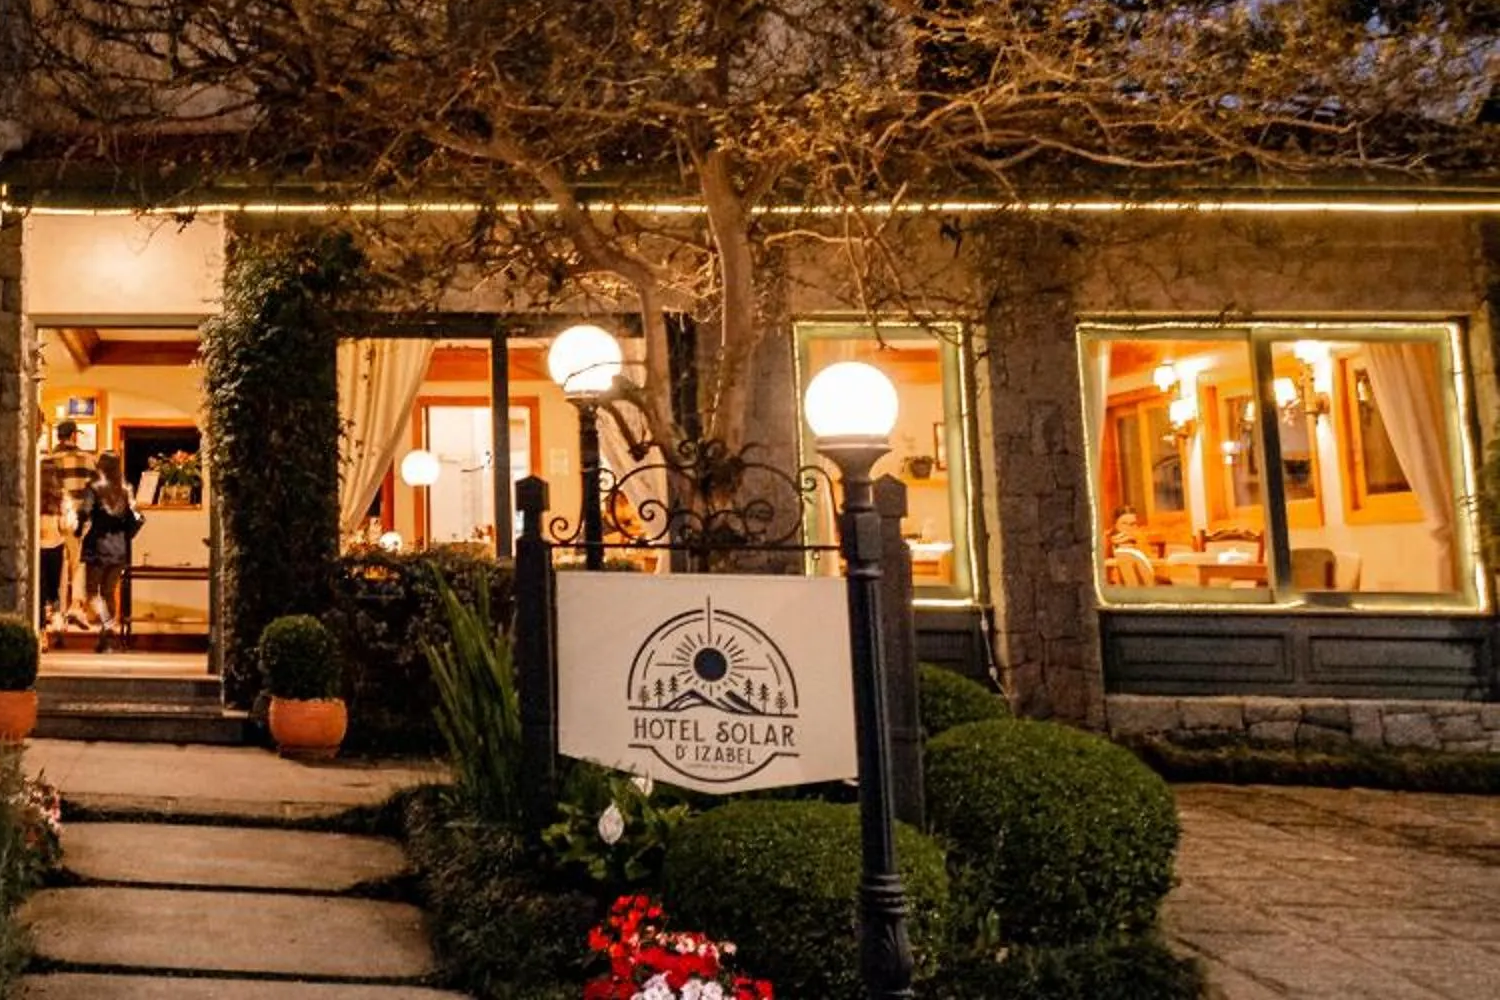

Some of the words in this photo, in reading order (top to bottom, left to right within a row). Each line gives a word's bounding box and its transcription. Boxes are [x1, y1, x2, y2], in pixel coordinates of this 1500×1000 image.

[633, 717, 706, 742] HOTEL
[715, 721, 796, 747] SOLAR
[695, 745, 756, 765] IZABEL
